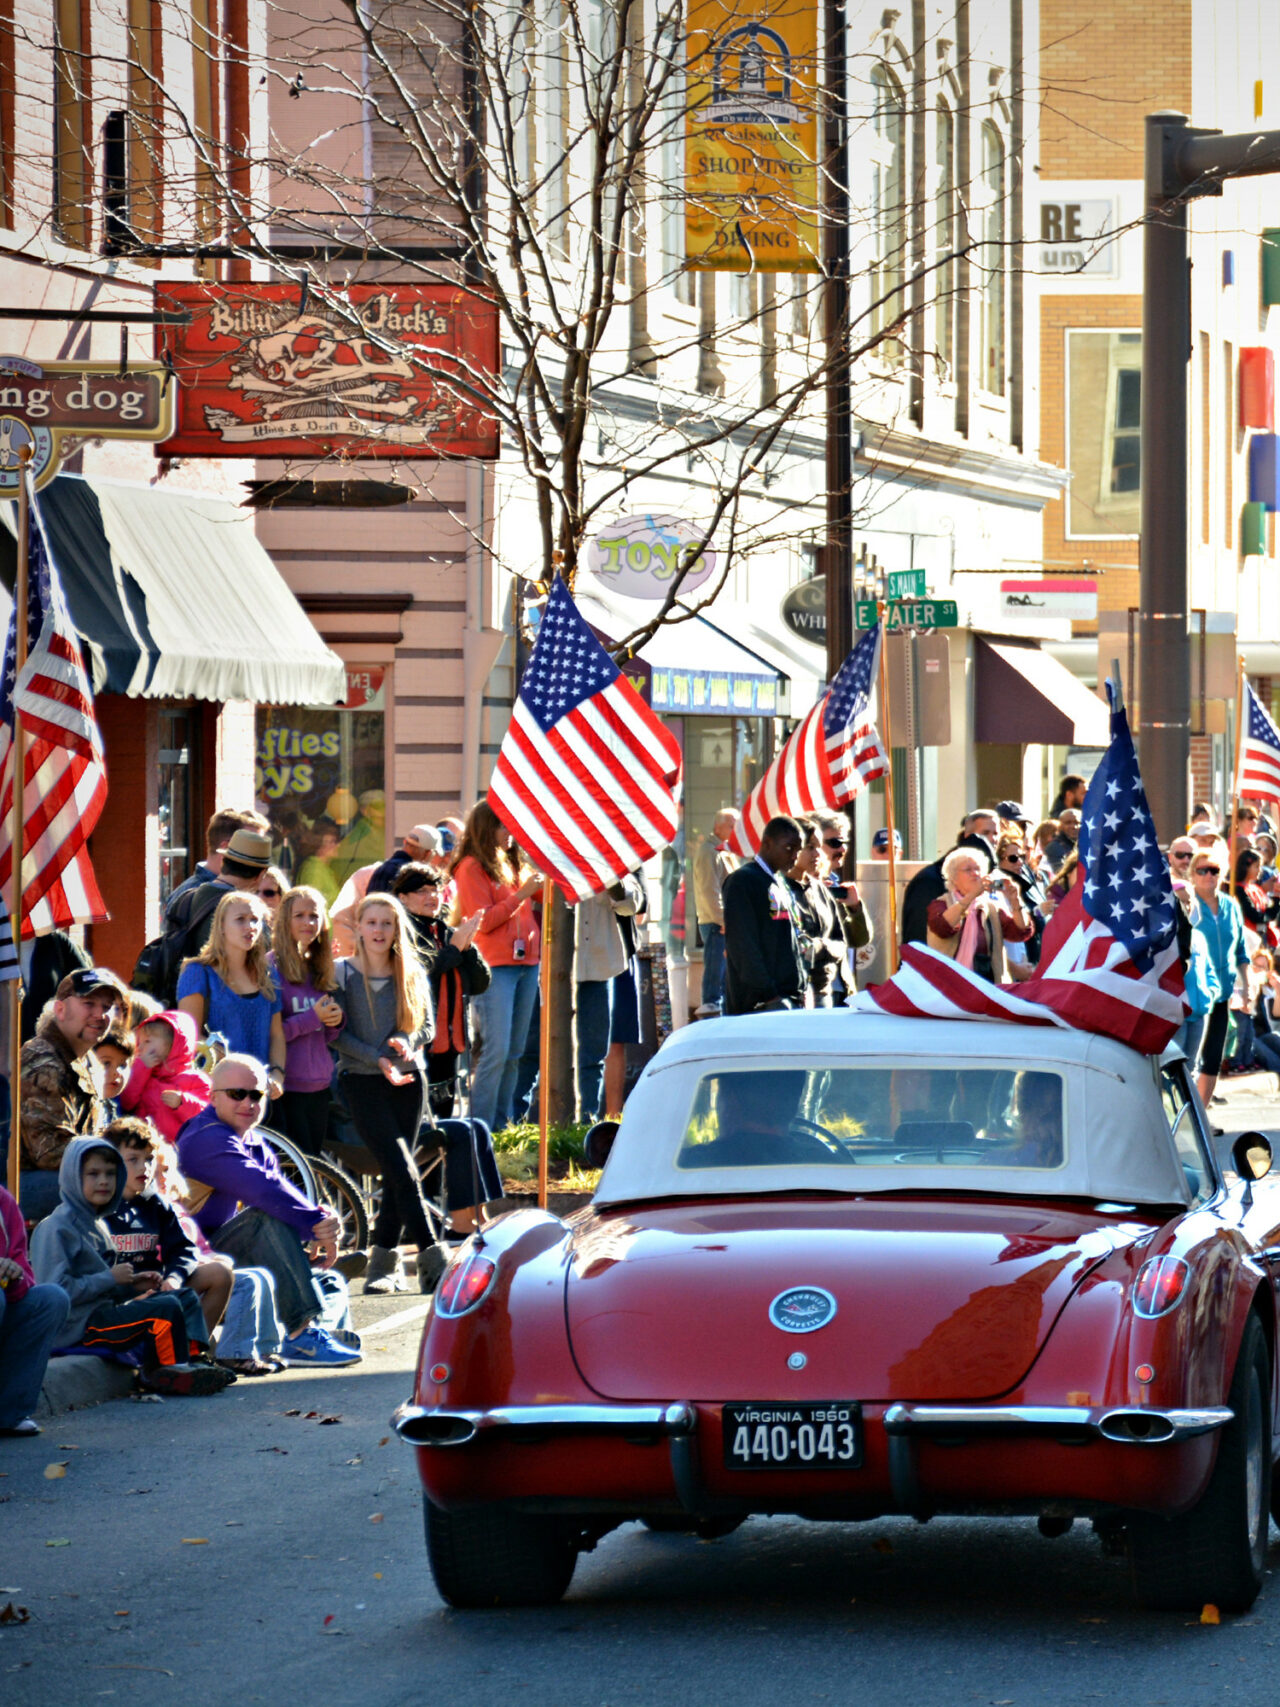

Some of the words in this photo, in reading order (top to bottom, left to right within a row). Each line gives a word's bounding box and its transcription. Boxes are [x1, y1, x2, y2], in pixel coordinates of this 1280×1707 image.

[698, 156, 804, 175] SHOPPING
[1041, 204, 1083, 242] RE
[207, 302, 274, 340] Billy
[362, 293, 448, 335] Jack's
[6, 360, 40, 375] STUFF
[65, 379, 146, 421] dog
[890, 575, 896, 597] S
[897, 572, 917, 596] MAIN
[858, 606, 870, 627] E
[943, 603, 955, 615] ST
[255, 728, 341, 761] flies
[733, 1411, 803, 1423] VIRGINIA
[810, 1409, 850, 1422] 1960
